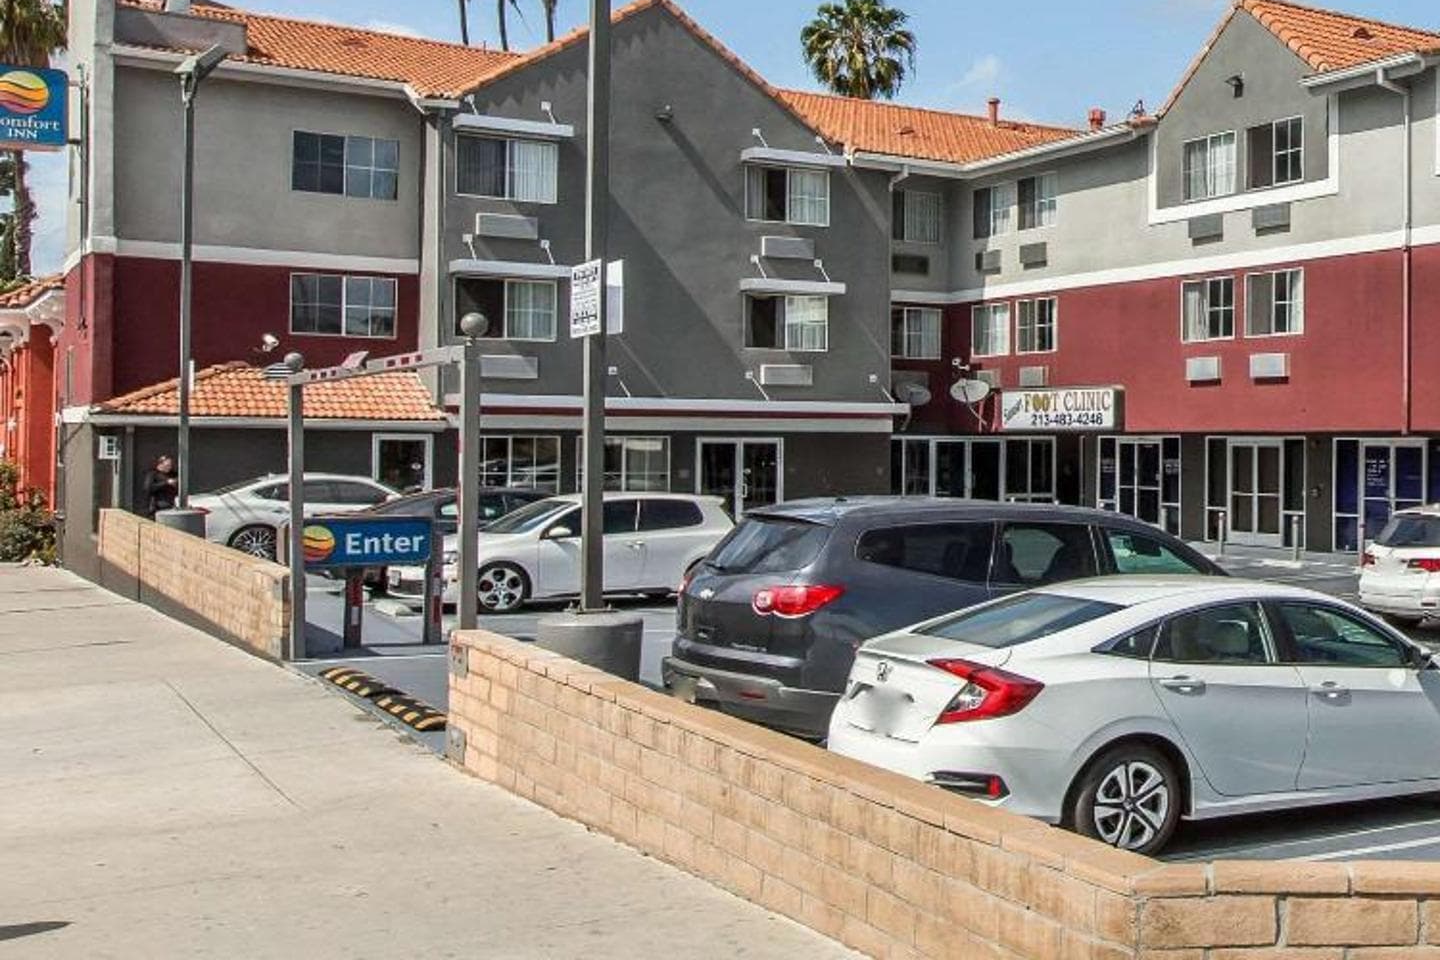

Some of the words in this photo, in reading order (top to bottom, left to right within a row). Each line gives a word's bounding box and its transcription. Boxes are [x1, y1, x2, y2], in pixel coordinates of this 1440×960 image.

[0, 114, 60, 131] omfort
[8, 128, 38, 139] INN
[1024, 393, 1058, 412] FOOT
[1063, 390, 1111, 411] CLINIC
[346, 532, 425, 555] Enter
